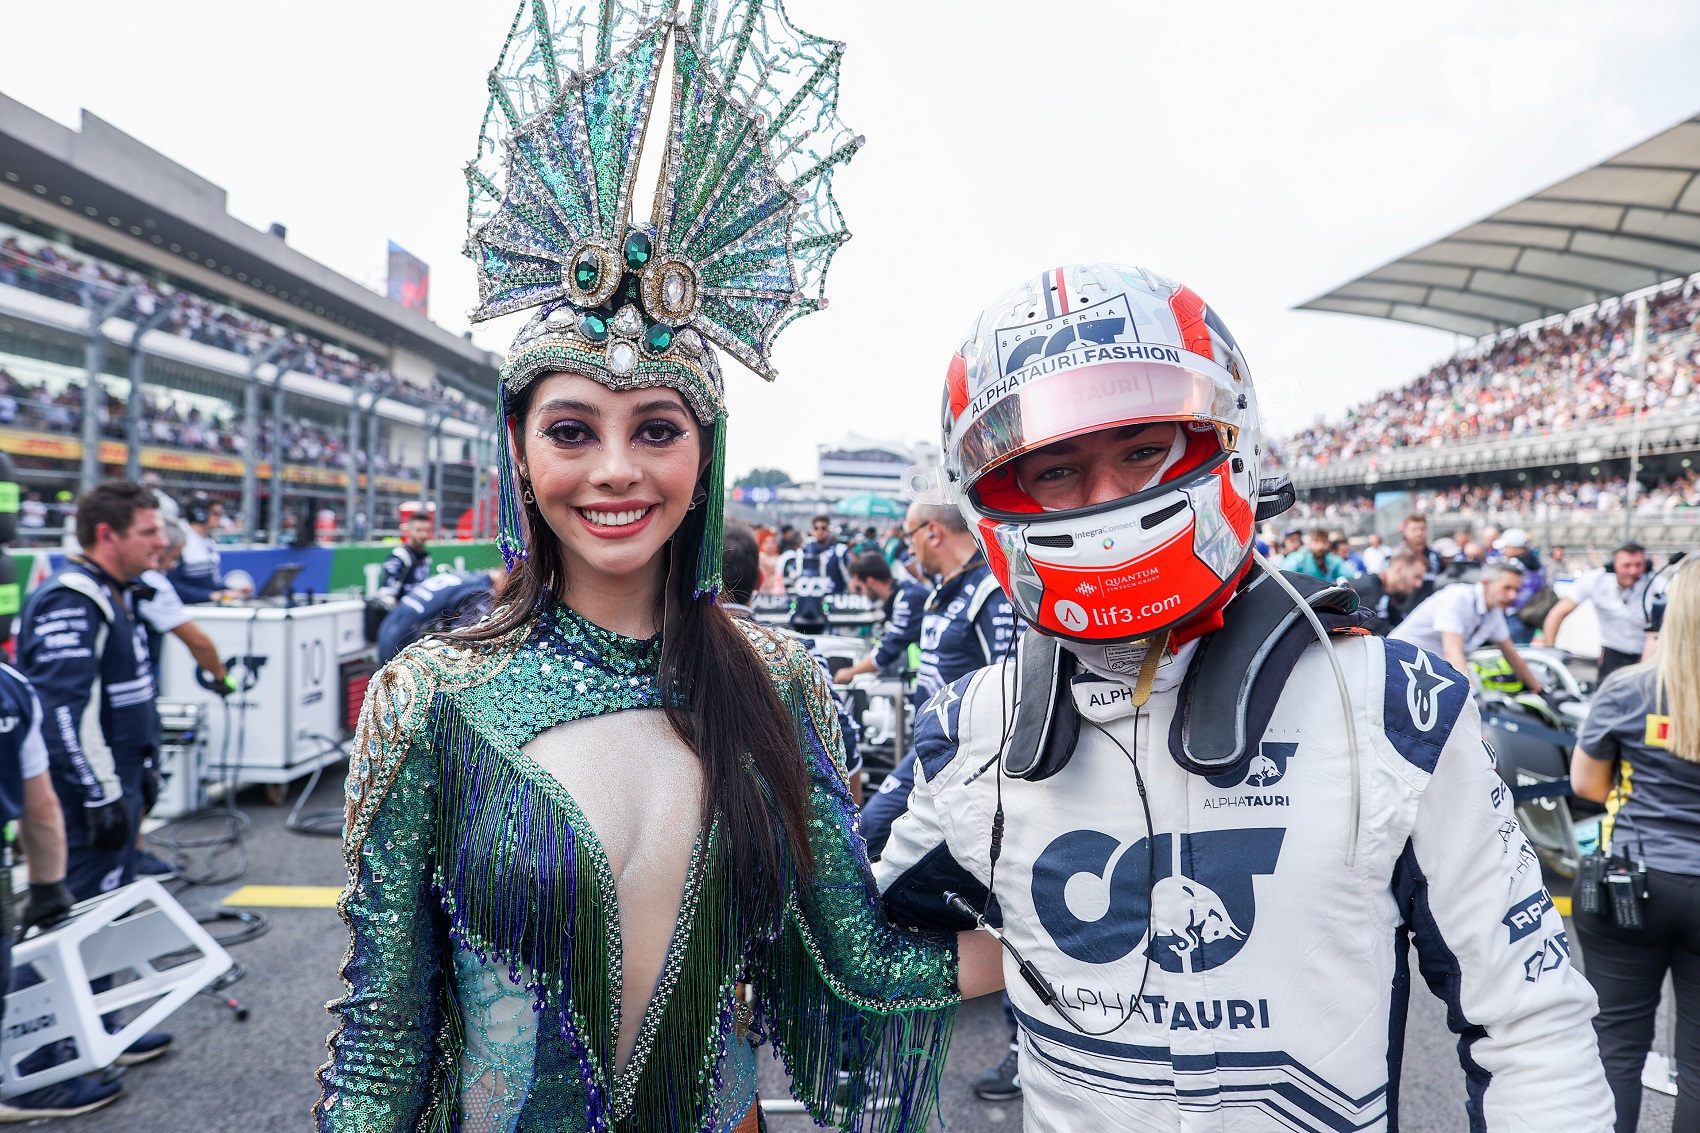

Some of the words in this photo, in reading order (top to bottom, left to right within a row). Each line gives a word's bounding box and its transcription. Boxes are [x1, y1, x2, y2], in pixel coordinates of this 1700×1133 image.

[1001, 307, 1117, 349] SCUDERIA
[971, 347, 1181, 419] ALPHATAURI.FASHION
[1074, 520, 1138, 540] IntegraConnect
[1104, 567, 1160, 587] QUANTUM
[1106, 583, 1137, 593] FINTECH
[1137, 575, 1161, 586] GROUP
[1092, 594, 1182, 627] lif3.com
[1089, 687, 1134, 707] ALPH
[1203, 795, 1290, 810] ALPHATAURI
